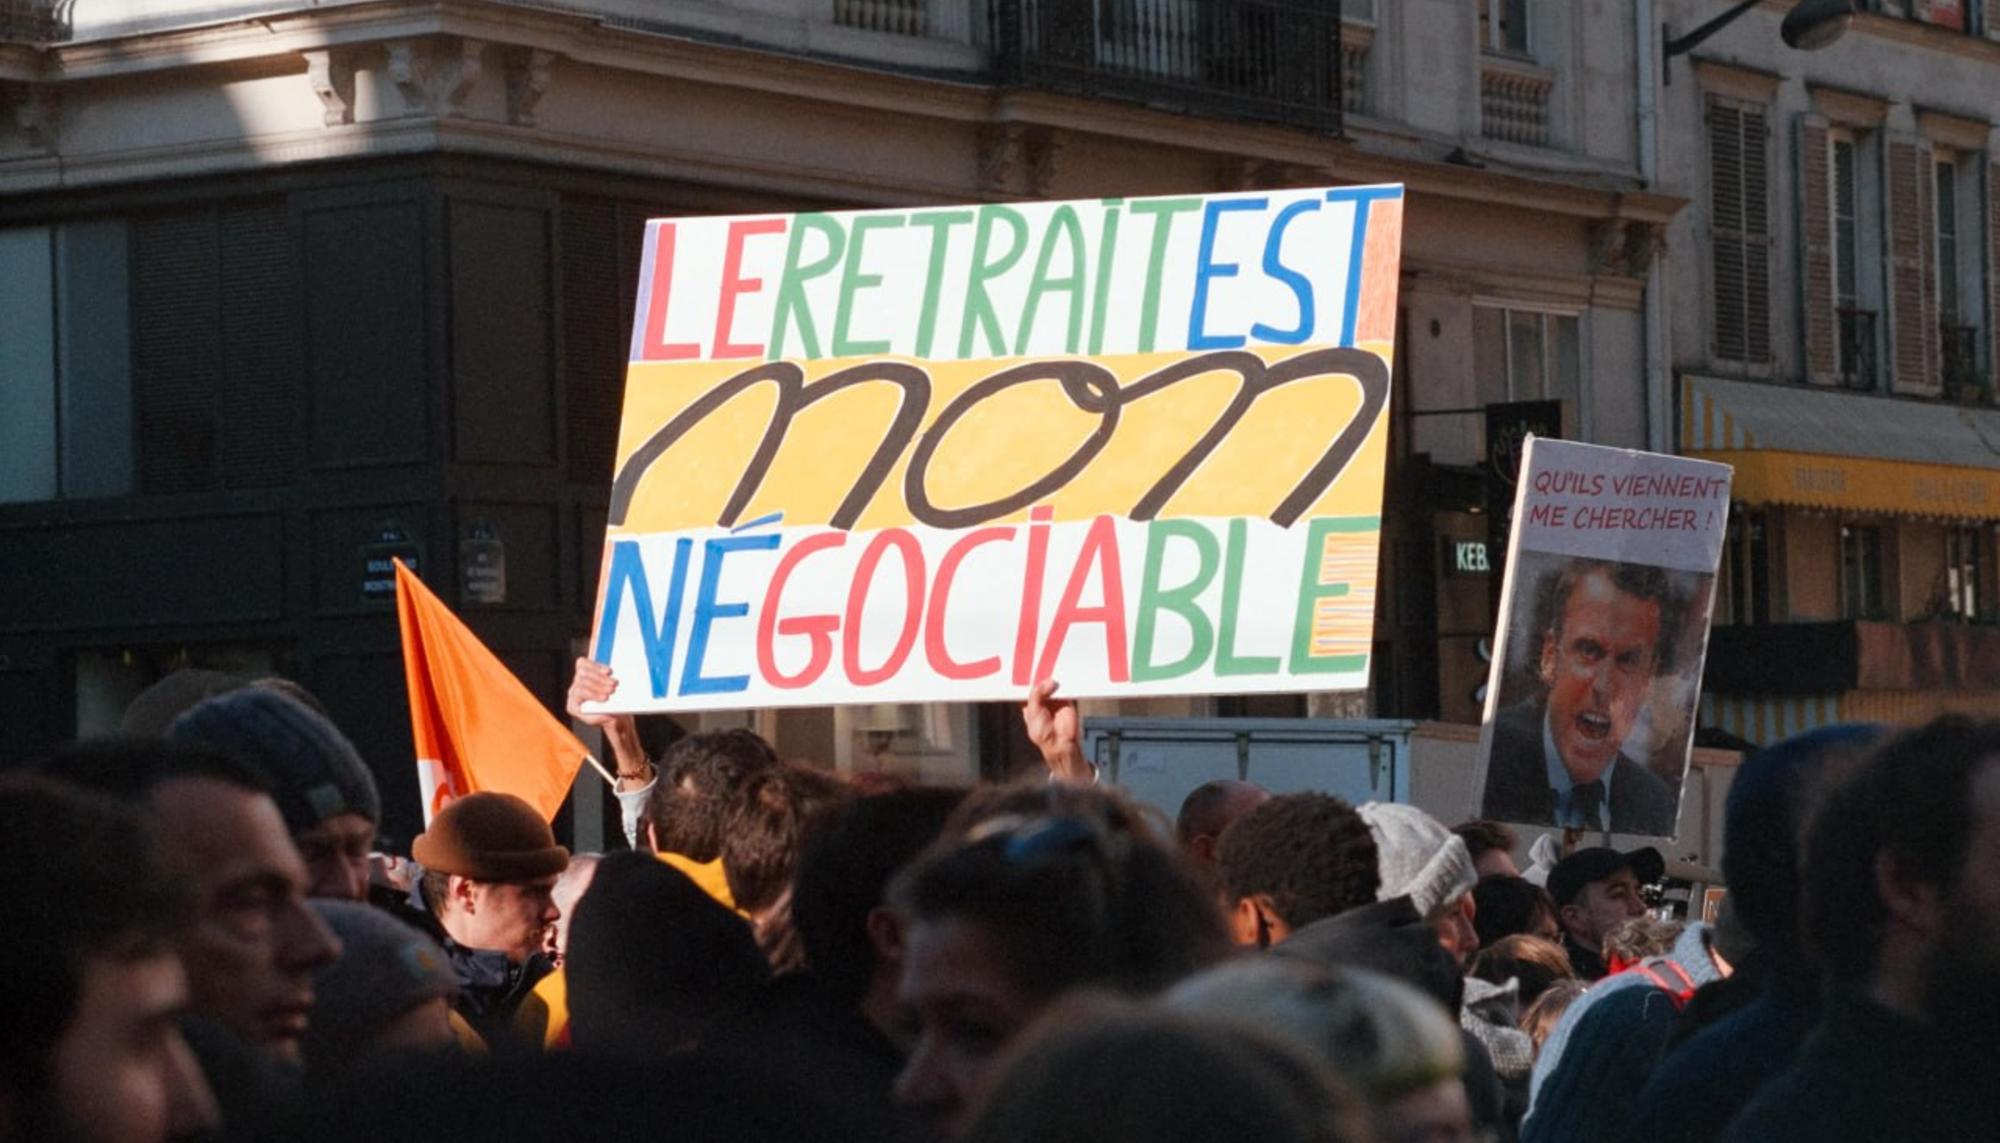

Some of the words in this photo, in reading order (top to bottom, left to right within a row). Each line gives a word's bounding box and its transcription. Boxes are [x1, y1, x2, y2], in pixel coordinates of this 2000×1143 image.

[642, 219, 787, 361] LE
[767, 198, 1203, 361] RETRAIT
[1187, 186, 1403, 350] EST
[1535, 470, 1605, 496] QU'ILS
[1612, 473, 1726, 500] VIENNENT
[1529, 503, 1568, 527] ME
[1572, 505, 1698, 531] CHERCHER
[1455, 542, 1491, 572] KEB
[594, 505, 1381, 699] NÉGOCIABLE
